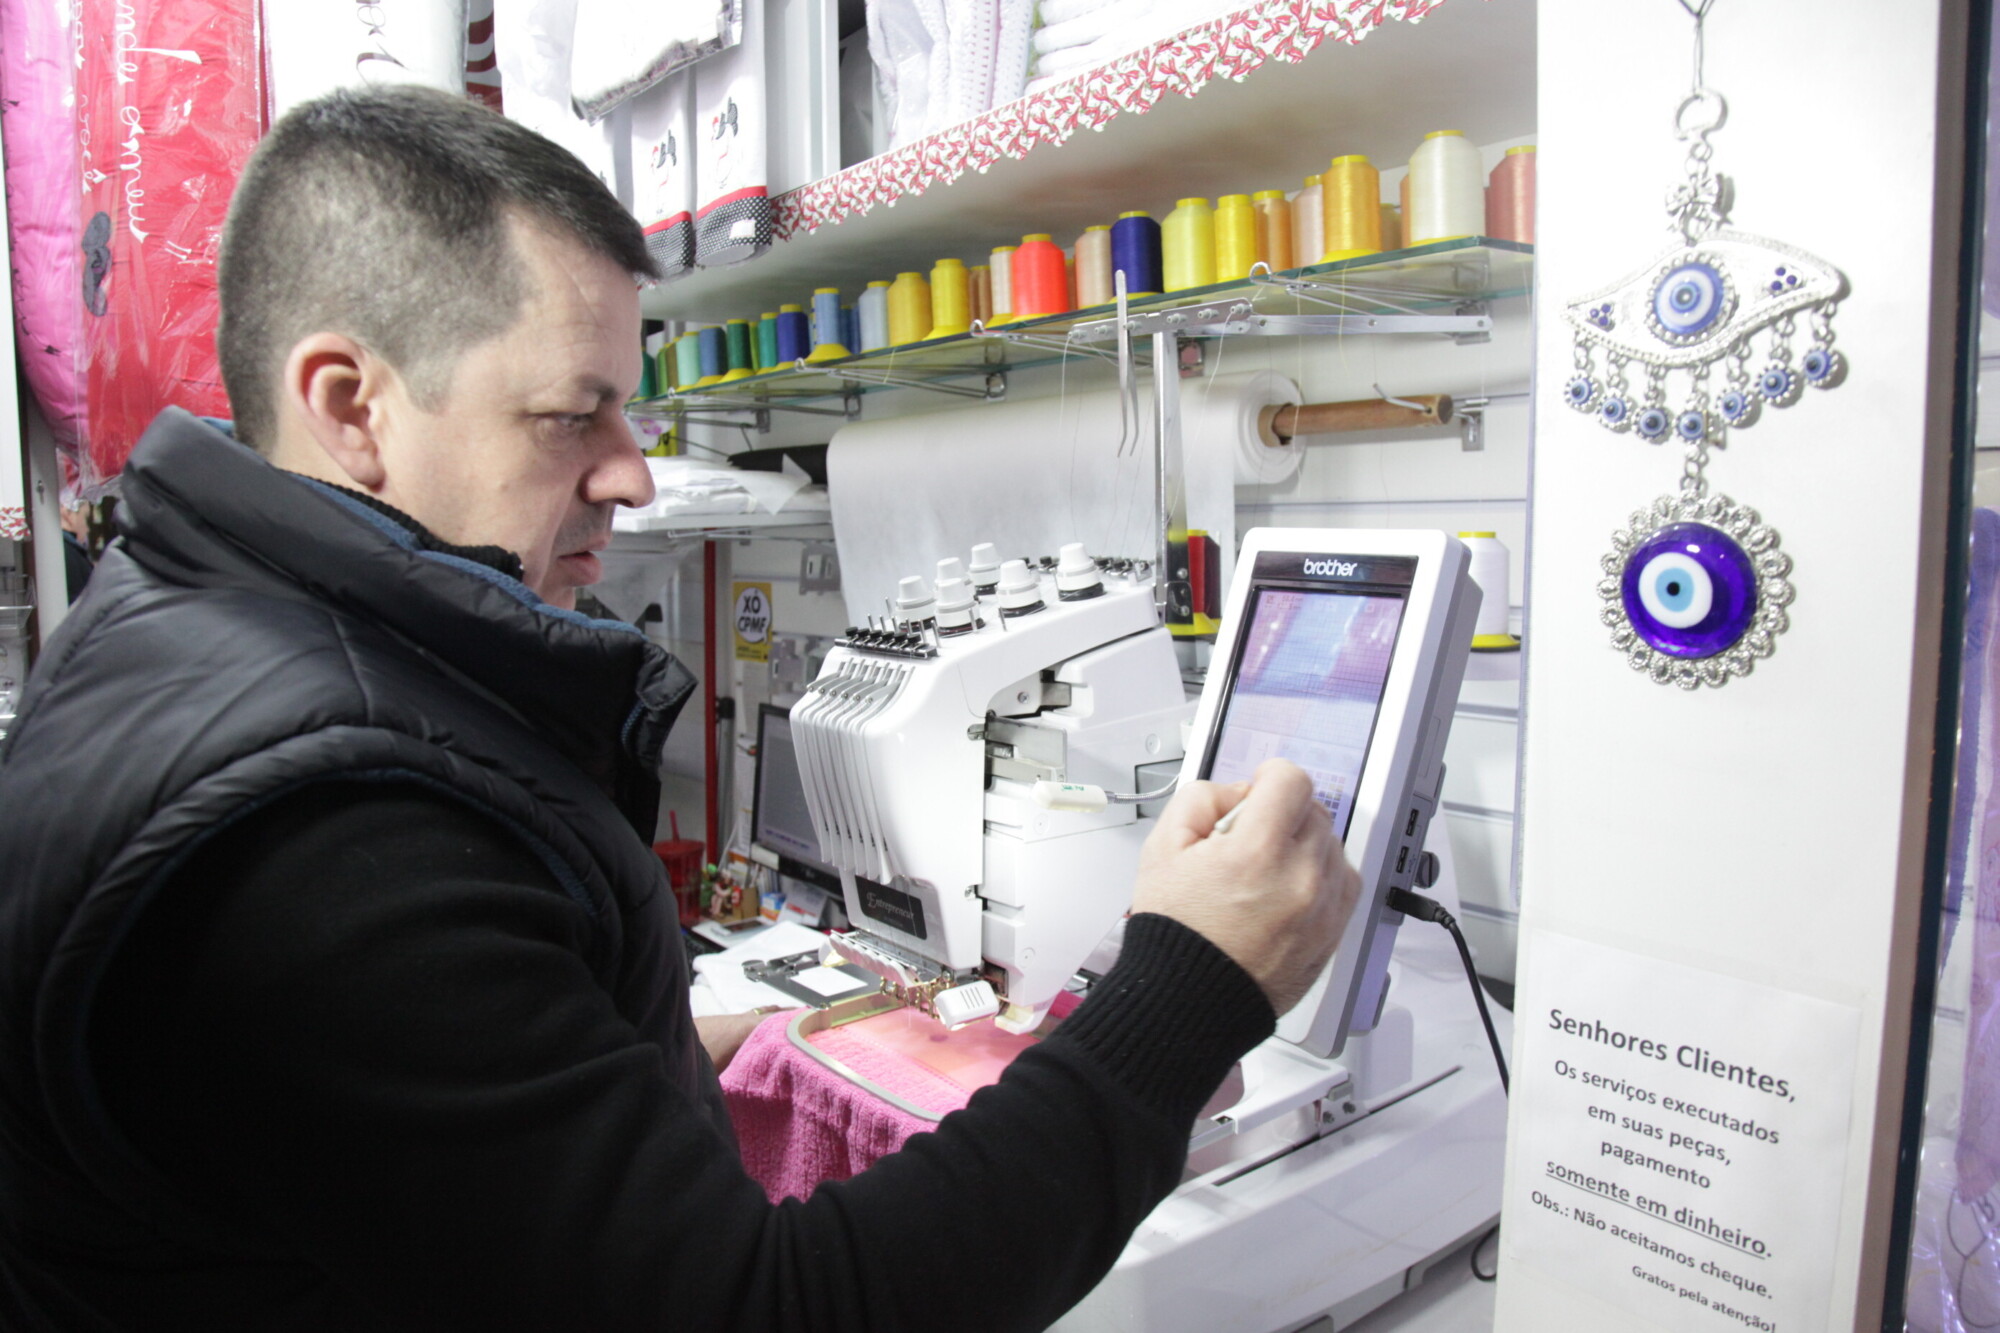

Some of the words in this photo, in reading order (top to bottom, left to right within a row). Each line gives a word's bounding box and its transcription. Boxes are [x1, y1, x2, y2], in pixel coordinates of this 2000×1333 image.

[1303, 558, 1358, 577] brother
[737, 615, 767, 633] CPMF
[1549, 1008, 1667, 1060] Senhores
[1676, 1045, 1796, 1103] Clientes,
[1554, 1059, 1577, 1080] Os
[1582, 1070, 1657, 1105] serviços
[1662, 1093, 1780, 1144] executados
[1587, 1104, 1616, 1125] em
[1621, 1115, 1664, 1140] suas
[1669, 1130, 1732, 1166] peças,
[1600, 1139, 1711, 1189] pagamento
[1546, 1160, 1631, 1202] somente
[1635, 1193, 1668, 1217] em
[1674, 1206, 1773, 1258] dinheiro.
[1531, 1190, 1570, 1217] Obs.:
[1573, 1207, 1606, 1231] Não
[1610, 1224, 1696, 1269] aceitamos
[1700, 1261, 1773, 1300] cheque.
[1631, 1264, 1676, 1292] Gratos
[1679, 1285, 1709, 1306] pela
[1712, 1299, 1777, 1333] atenção!
